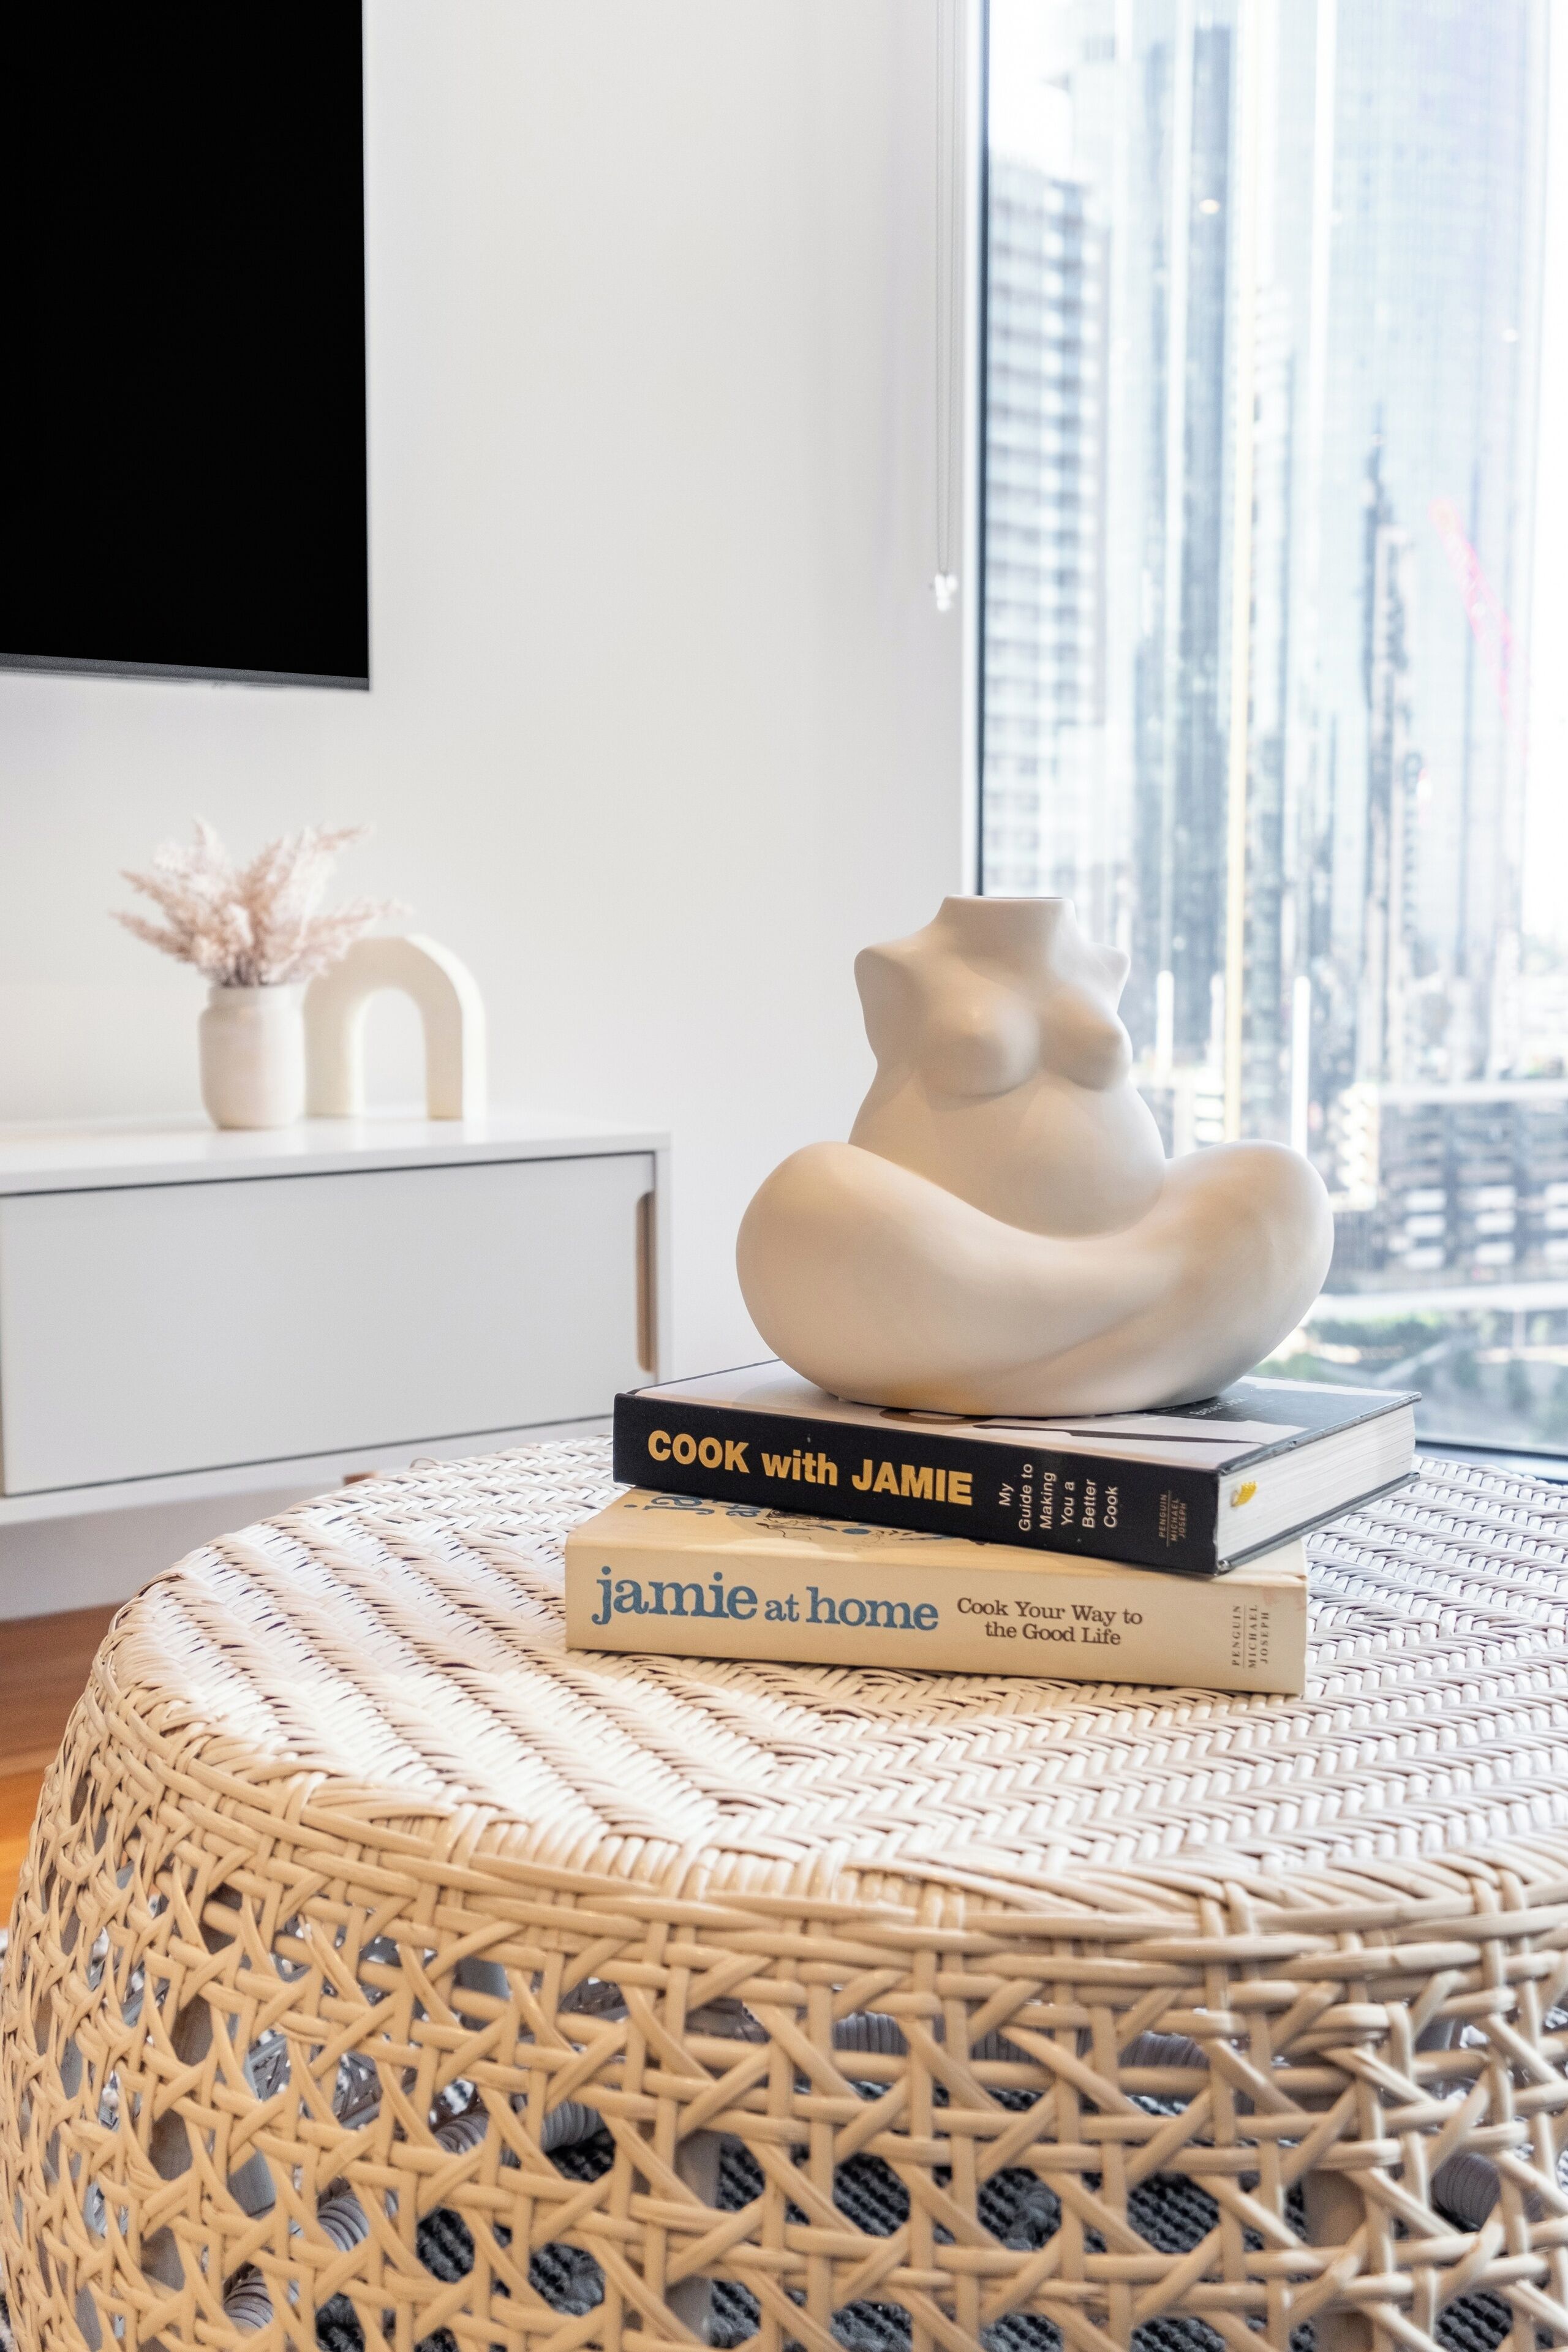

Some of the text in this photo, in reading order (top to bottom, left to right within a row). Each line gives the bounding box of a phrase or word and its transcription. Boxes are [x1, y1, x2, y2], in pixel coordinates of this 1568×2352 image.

[648, 1430, 973, 1506] COOK with JAMIE
[998, 1482, 1015, 1506] My
[1018, 1463, 1034, 1531] Guide to
[1039, 1472, 1057, 1529] Making
[1060, 1481, 1076, 1526] You a
[1081, 1479, 1097, 1529] Better
[1103, 1486, 1118, 1528] Cook
[1158, 1493, 1167, 1539] PENGUIN
[1169, 1498, 1179, 1542] MICHAEL
[1178, 1502, 1187, 1539] JOSEPH
[592, 1566, 939, 1630] jamie at home
[957, 1597, 1143, 1625] Cook Your Way to
[986, 1621, 1121, 1645] the Good Life
[1231, 1605, 1241, 1666] PENGUIN
[1248, 1604, 1258, 1669] MICHAEL
[1259, 1611, 1270, 1665] JOSEPH
